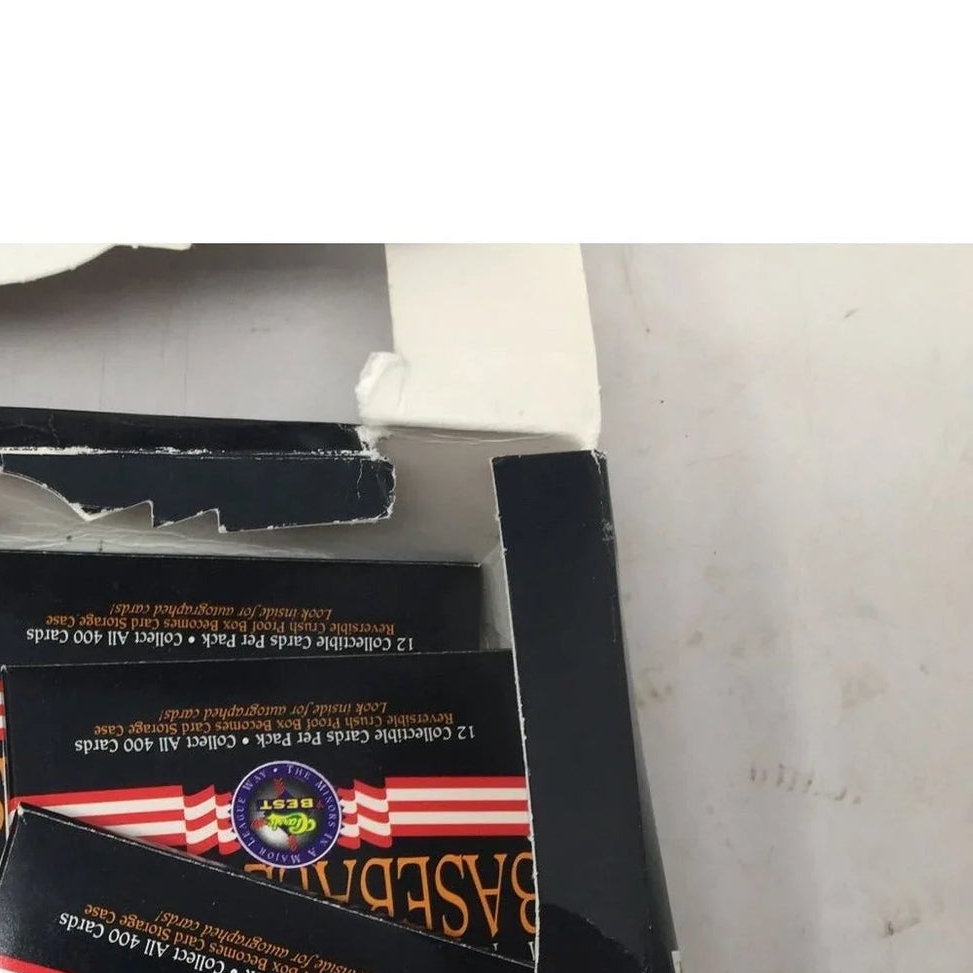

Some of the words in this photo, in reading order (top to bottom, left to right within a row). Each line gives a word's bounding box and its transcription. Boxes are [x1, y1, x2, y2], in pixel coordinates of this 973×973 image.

[110, 603, 150, 616] cards!
[154, 602, 234, 618] autographed
[239, 604, 261, 619] for
[261, 607, 298, 619] inside
[300, 608, 332, 621] Look
[46, 615, 75, 627] Case
[79, 615, 127, 629] Storage
[130, 617, 160, 630] Card
[163, 618, 218, 631] Becomes
[223, 620, 247, 632] Box
[252, 620, 284, 633] Proof
[290, 621, 326, 634] Crush
[26, 628, 69, 644] Cards
[329, 622, 395, 636] Reversible
[73, 629, 103, 644] 400
[108, 630, 129, 646] All
[134, 631, 183, 647] Collect
[201, 633, 236, 648] Pack
[241, 634, 265, 648] Per
[270, 634, 312, 650] Cards
[316, 636, 392, 652] Collectible
[396, 637, 414, 651] 12
[204, 704, 287, 718] autographed
[293, 702, 314, 717] for
[313, 702, 352, 715] inside
[355, 701, 387, 714] Look
[159, 708, 200, 722] cards!
[344, 715, 382, 728] Crush
[386, 712, 454, 725] Reversible
[128, 721, 177, 735] Storage
[181, 721, 211, 735] Card
[215, 720, 272, 732] Becomes
[277, 718, 301, 731] Box
[306, 716, 340, 730] Proof
[94, 724, 124, 737] Case
[327, 729, 370, 746] Cards
[374, 726, 452, 744] Collectible
[457, 725, 475, 740] 12
[123, 738, 154, 752] 400
[159, 736, 181, 752] All
[186, 734, 236, 748] Collect
[255, 732, 291, 747] Pack
[297, 731, 322, 746] Per
[75, 738, 119, 755] Cards
[259, 798, 314, 810] BEST
[244, 852, 536, 938] BASEBA
[84, 904, 116, 924] Case
[154, 910, 200, 930] cards!
[58, 911, 105, 939] Cards
[119, 914, 171, 940] Storage
[108, 928, 141, 950] 400
[173, 931, 205, 951] Card
[201, 924, 290, 959] autographed
[144, 937, 171, 958] All
[209, 942, 268, 971] Becomes
[291, 954, 319, 969] for
